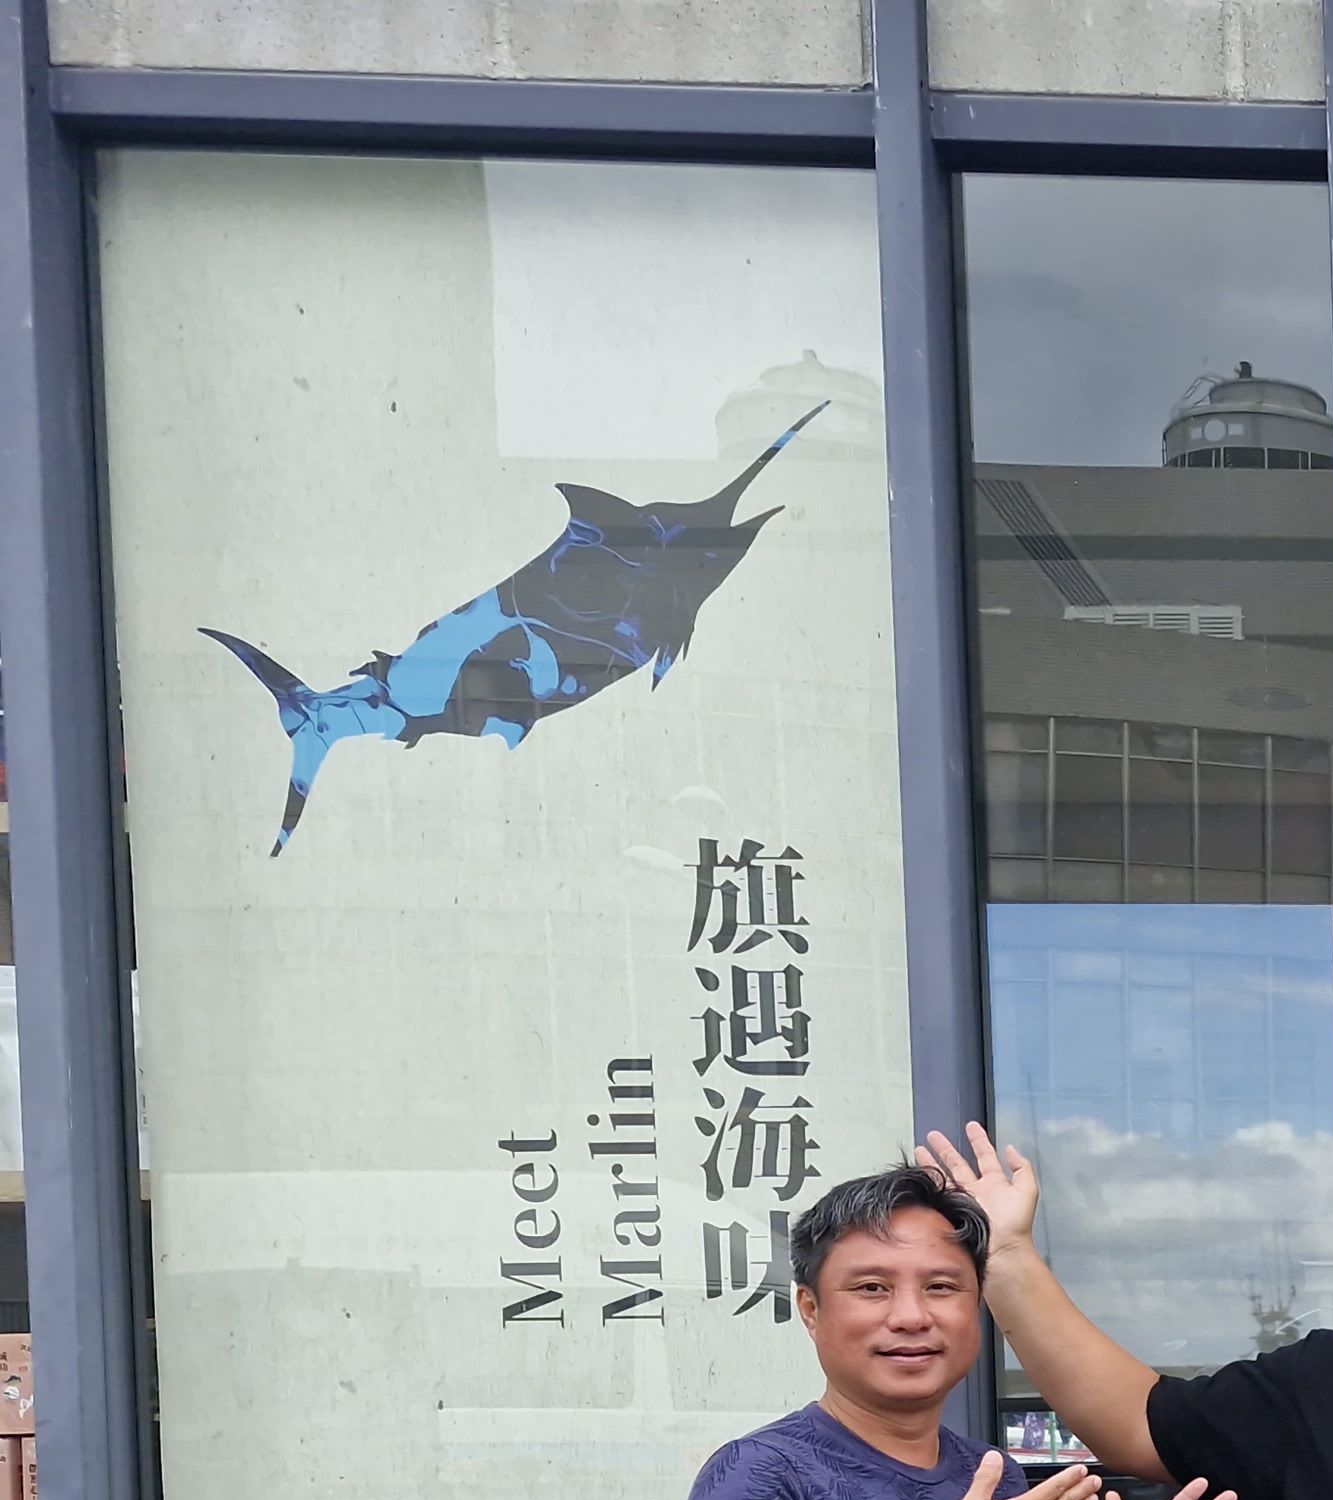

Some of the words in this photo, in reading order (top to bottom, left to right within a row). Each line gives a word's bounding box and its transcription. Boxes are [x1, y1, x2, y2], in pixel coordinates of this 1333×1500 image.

[588, 1053, 666, 1330] Marlin
[683, 838, 822, 1325] 旗遇海味
[497, 1128, 565, 1330] Meet
